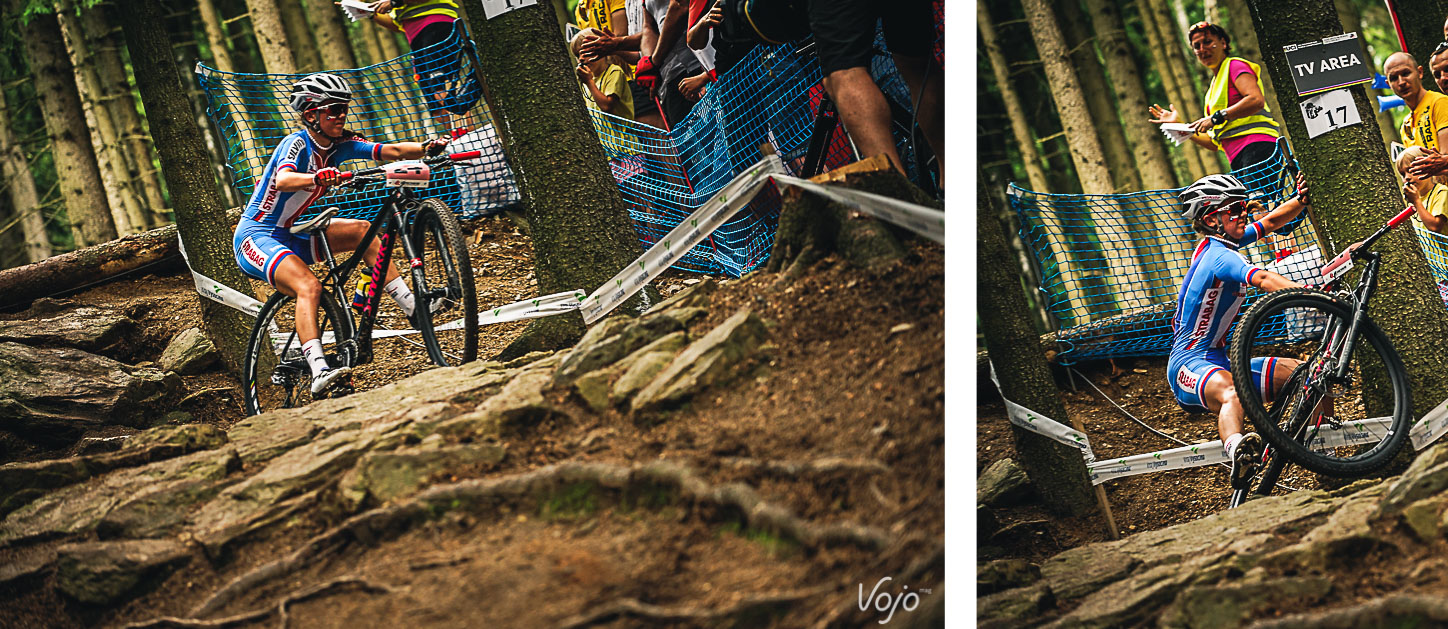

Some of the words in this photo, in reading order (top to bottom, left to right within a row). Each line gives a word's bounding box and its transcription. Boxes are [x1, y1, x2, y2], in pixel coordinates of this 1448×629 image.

[1294, 62, 1315, 77] TV
[1320, 53, 1362, 73] AREA
[1325, 106, 1347, 128] 17
[262, 171, 279, 211] STRAB
[242, 240, 265, 267] STRABAG
[1195, 289, 1219, 337] STRABAG
